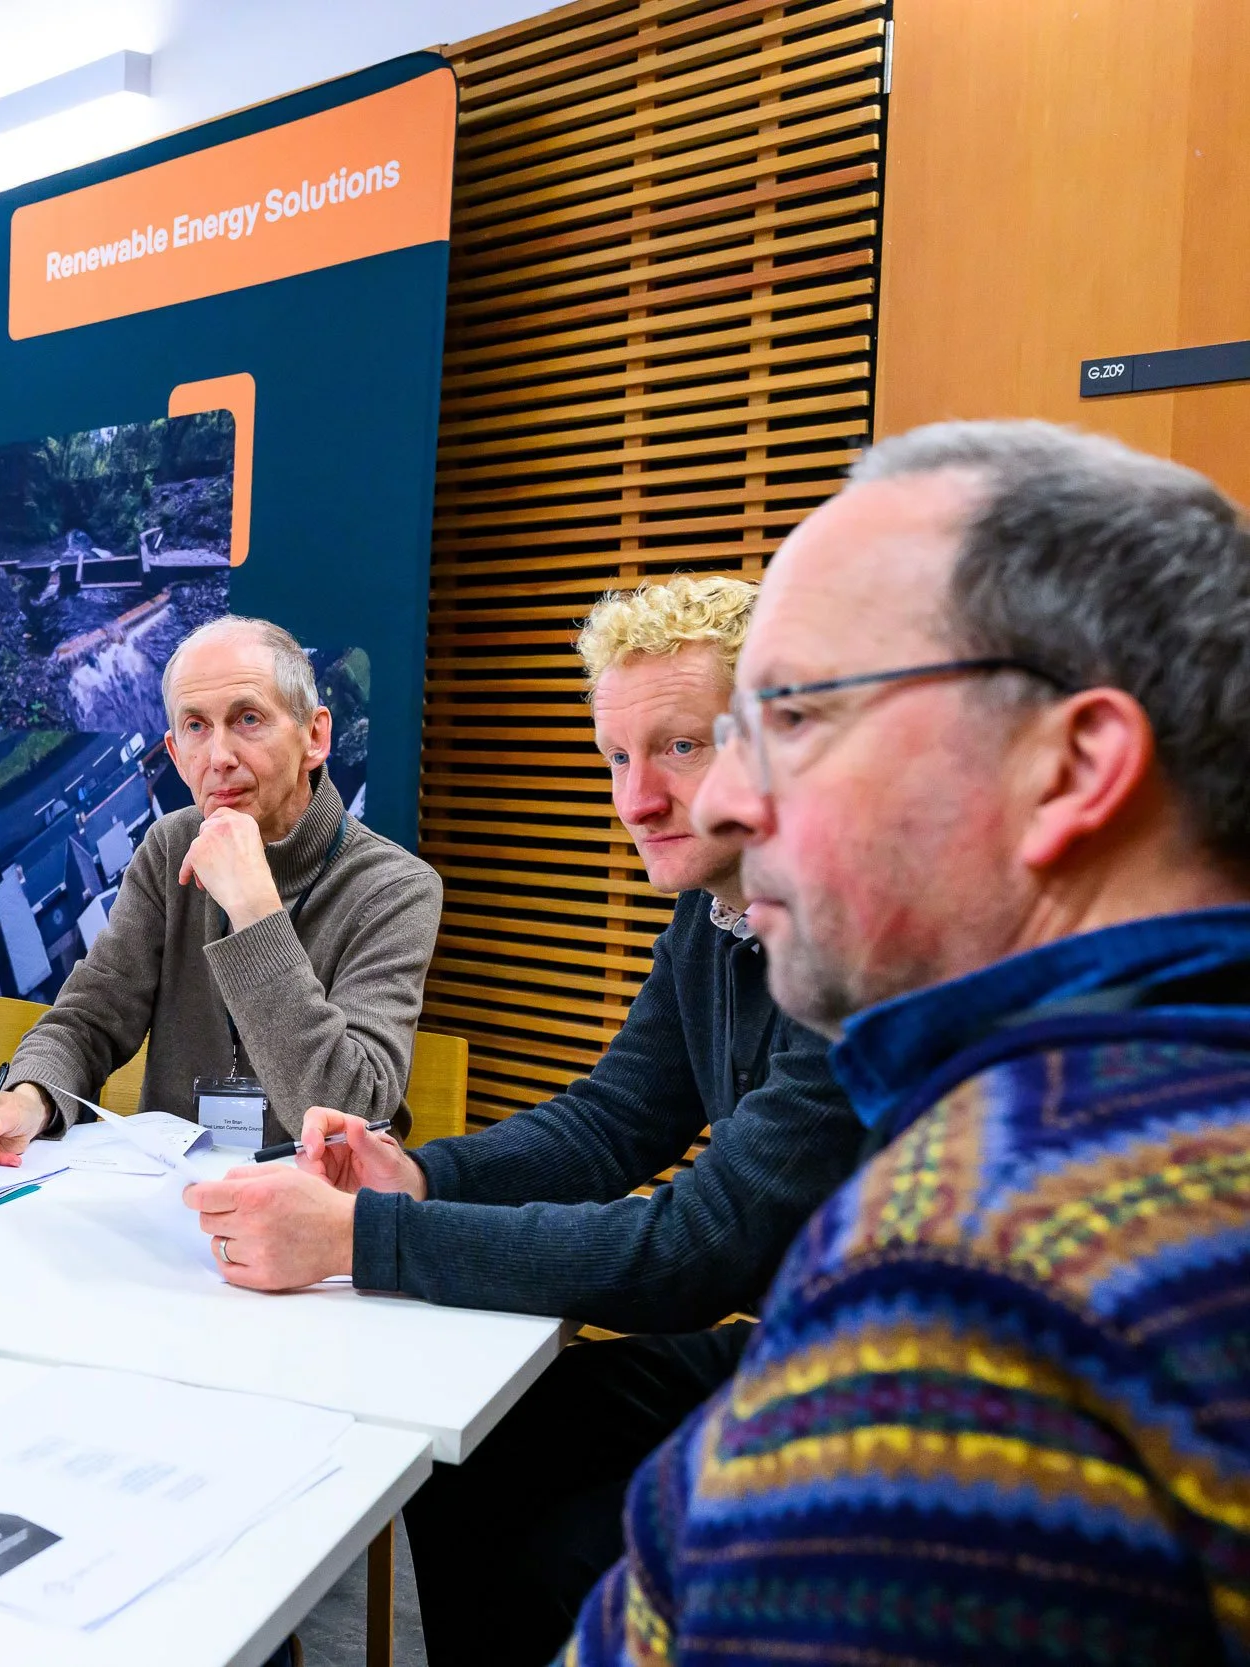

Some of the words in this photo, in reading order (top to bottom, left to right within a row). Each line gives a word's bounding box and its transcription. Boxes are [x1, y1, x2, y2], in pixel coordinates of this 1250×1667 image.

[45, 224, 168, 282] Renewable
[172, 201, 261, 249] Energy
[264, 158, 400, 223] Solutions
